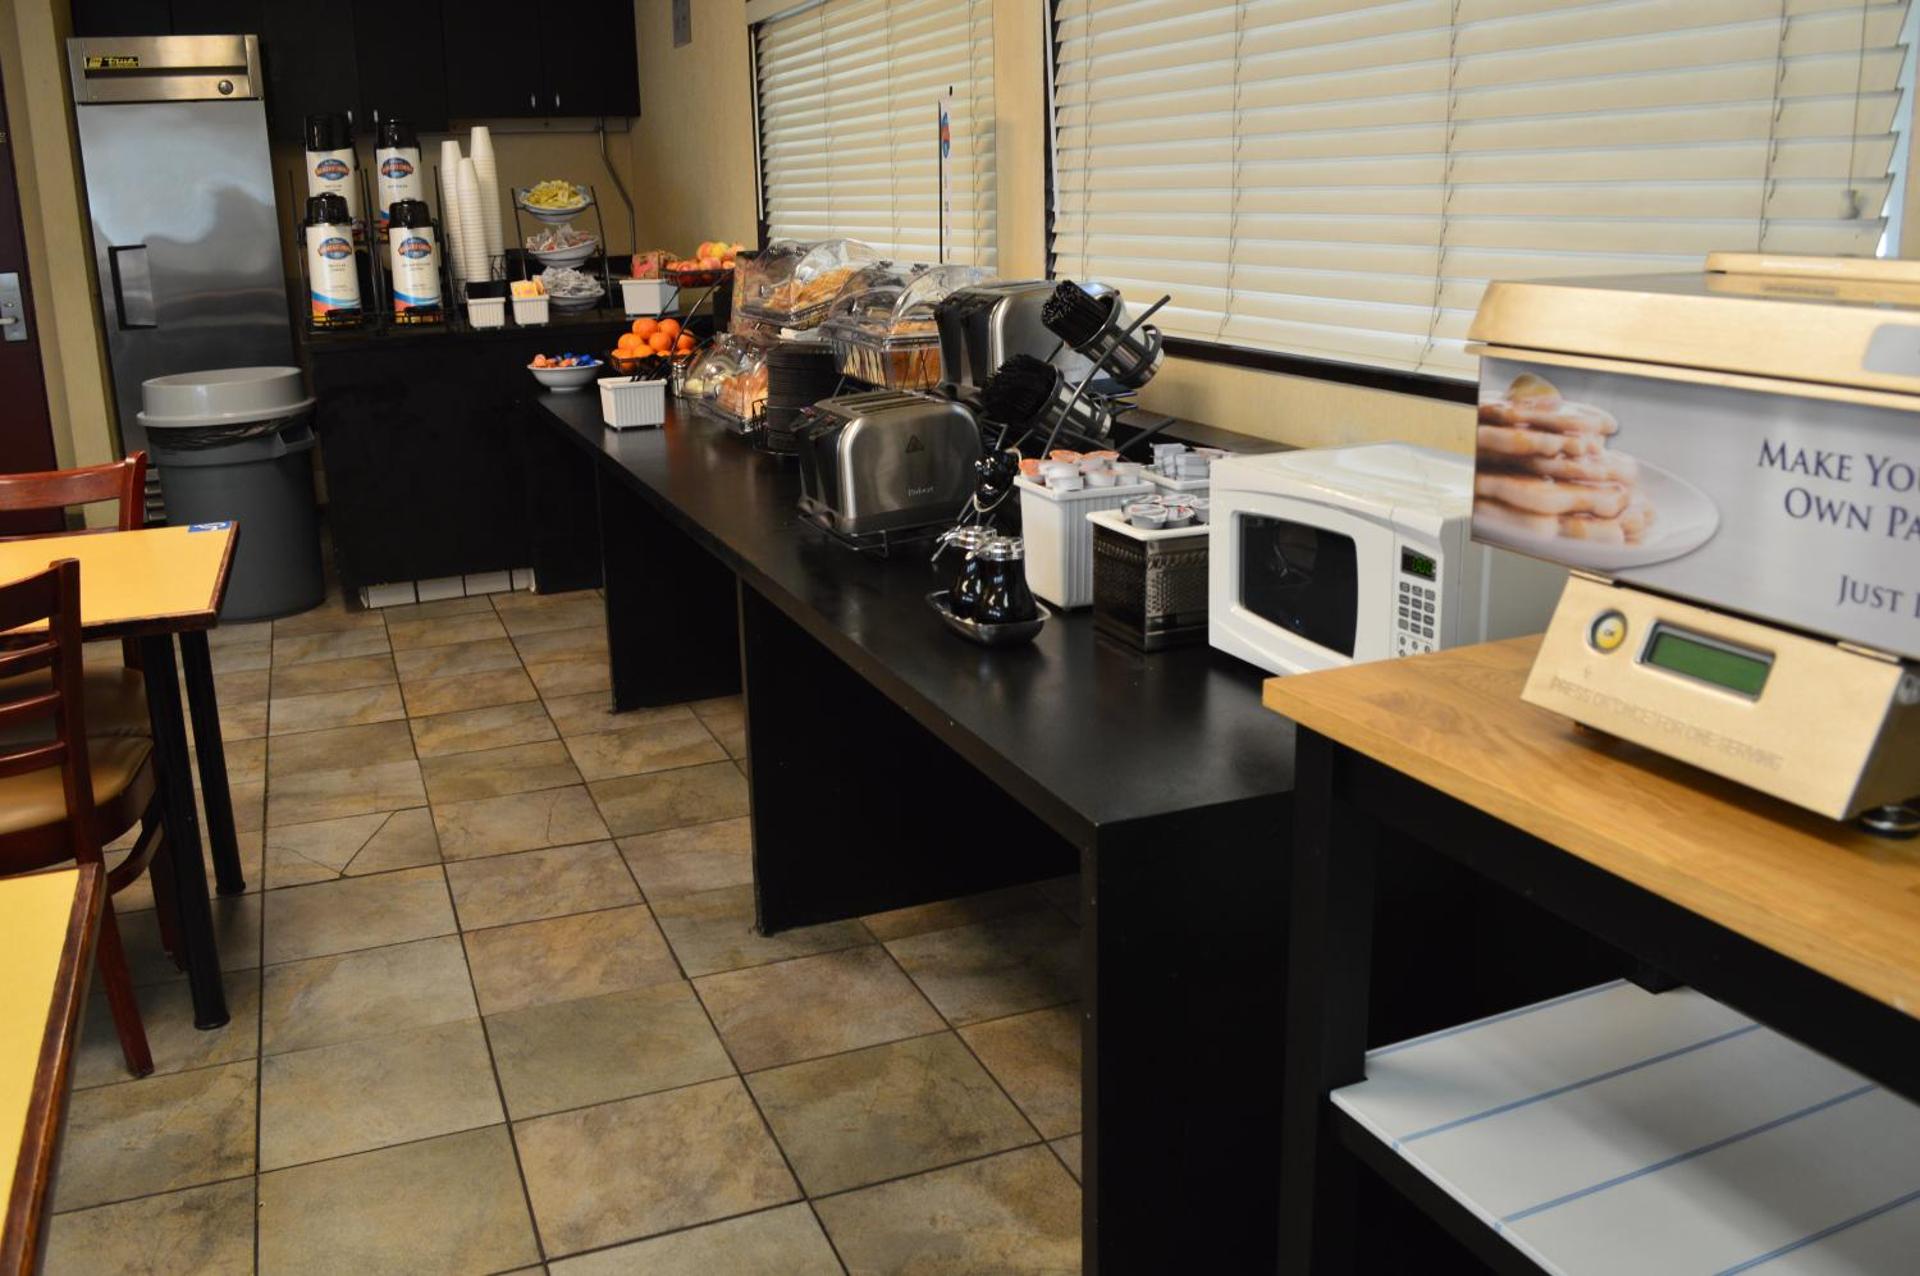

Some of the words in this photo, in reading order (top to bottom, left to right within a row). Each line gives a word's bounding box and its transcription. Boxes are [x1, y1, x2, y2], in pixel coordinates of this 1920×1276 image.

[1758, 438, 1853, 482] MAKE
[1784, 487, 1873, 532] OWN
[1837, 574, 1904, 613] JUST
